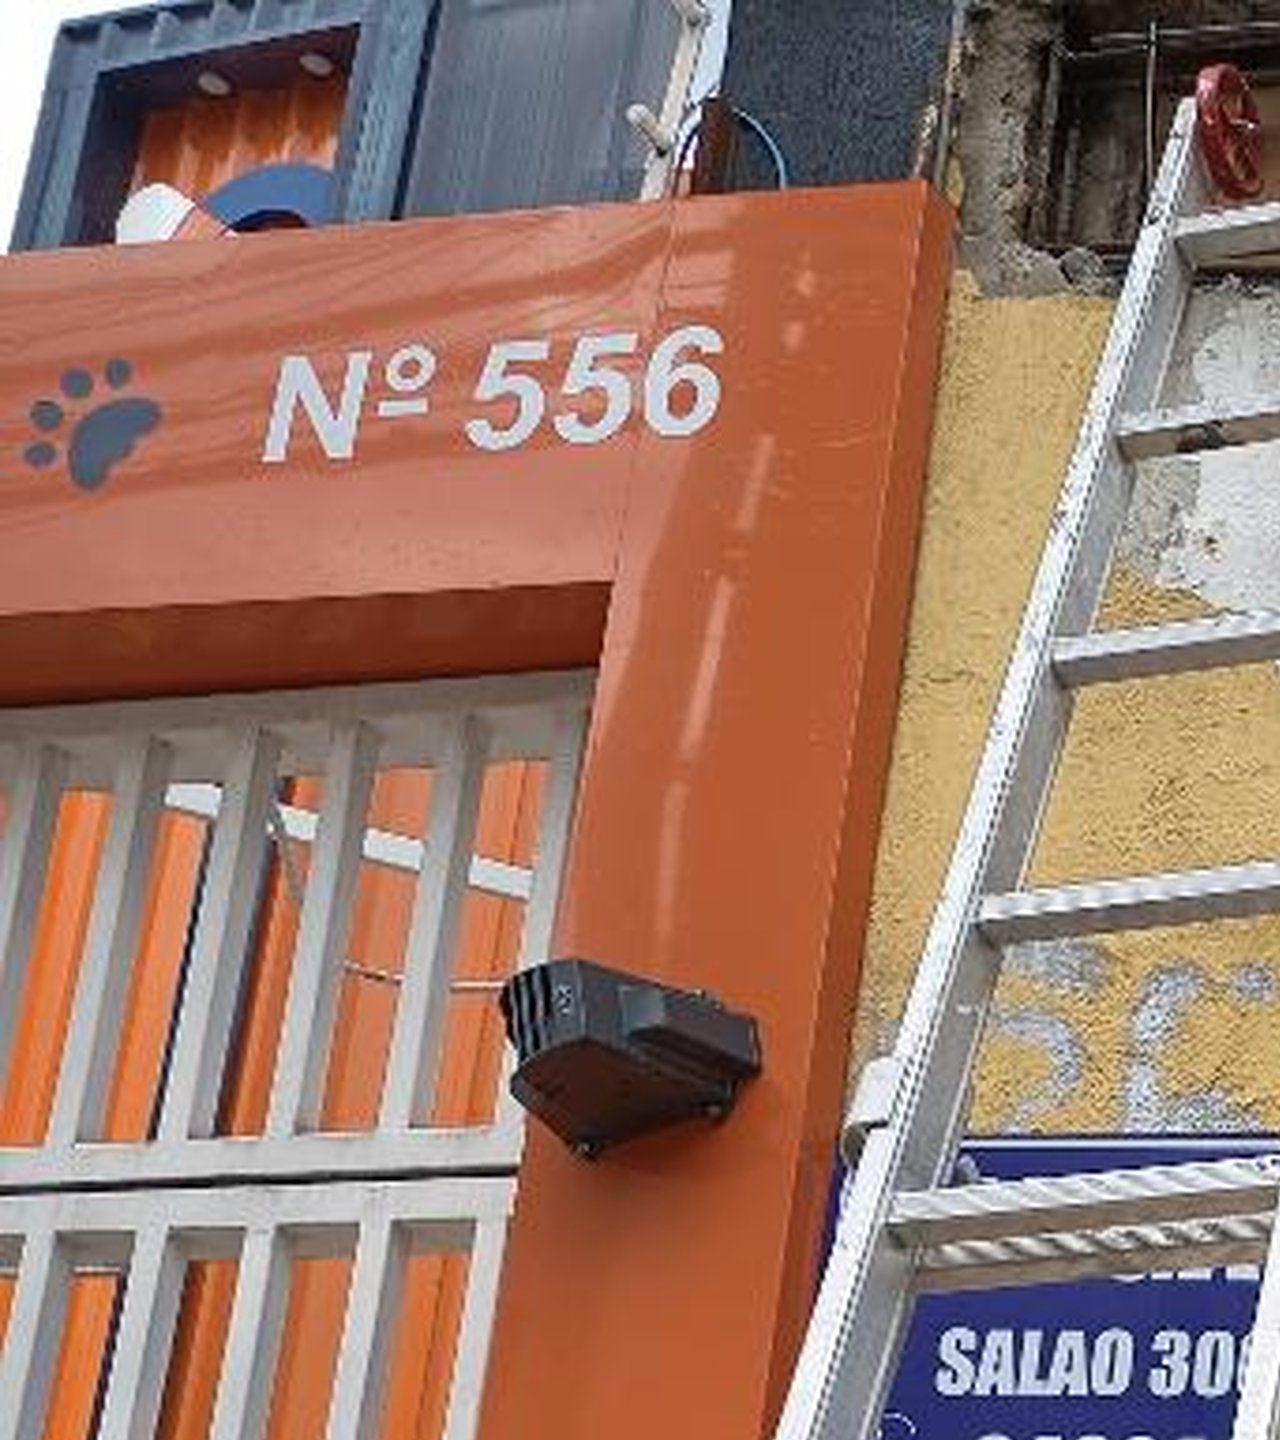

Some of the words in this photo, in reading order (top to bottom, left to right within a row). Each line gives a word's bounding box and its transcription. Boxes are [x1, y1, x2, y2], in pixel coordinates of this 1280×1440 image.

[464, 325, 724, 452] 556
[936, 1326, 1134, 1397] SALAO
[1148, 1328, 1252, 1397] 30
